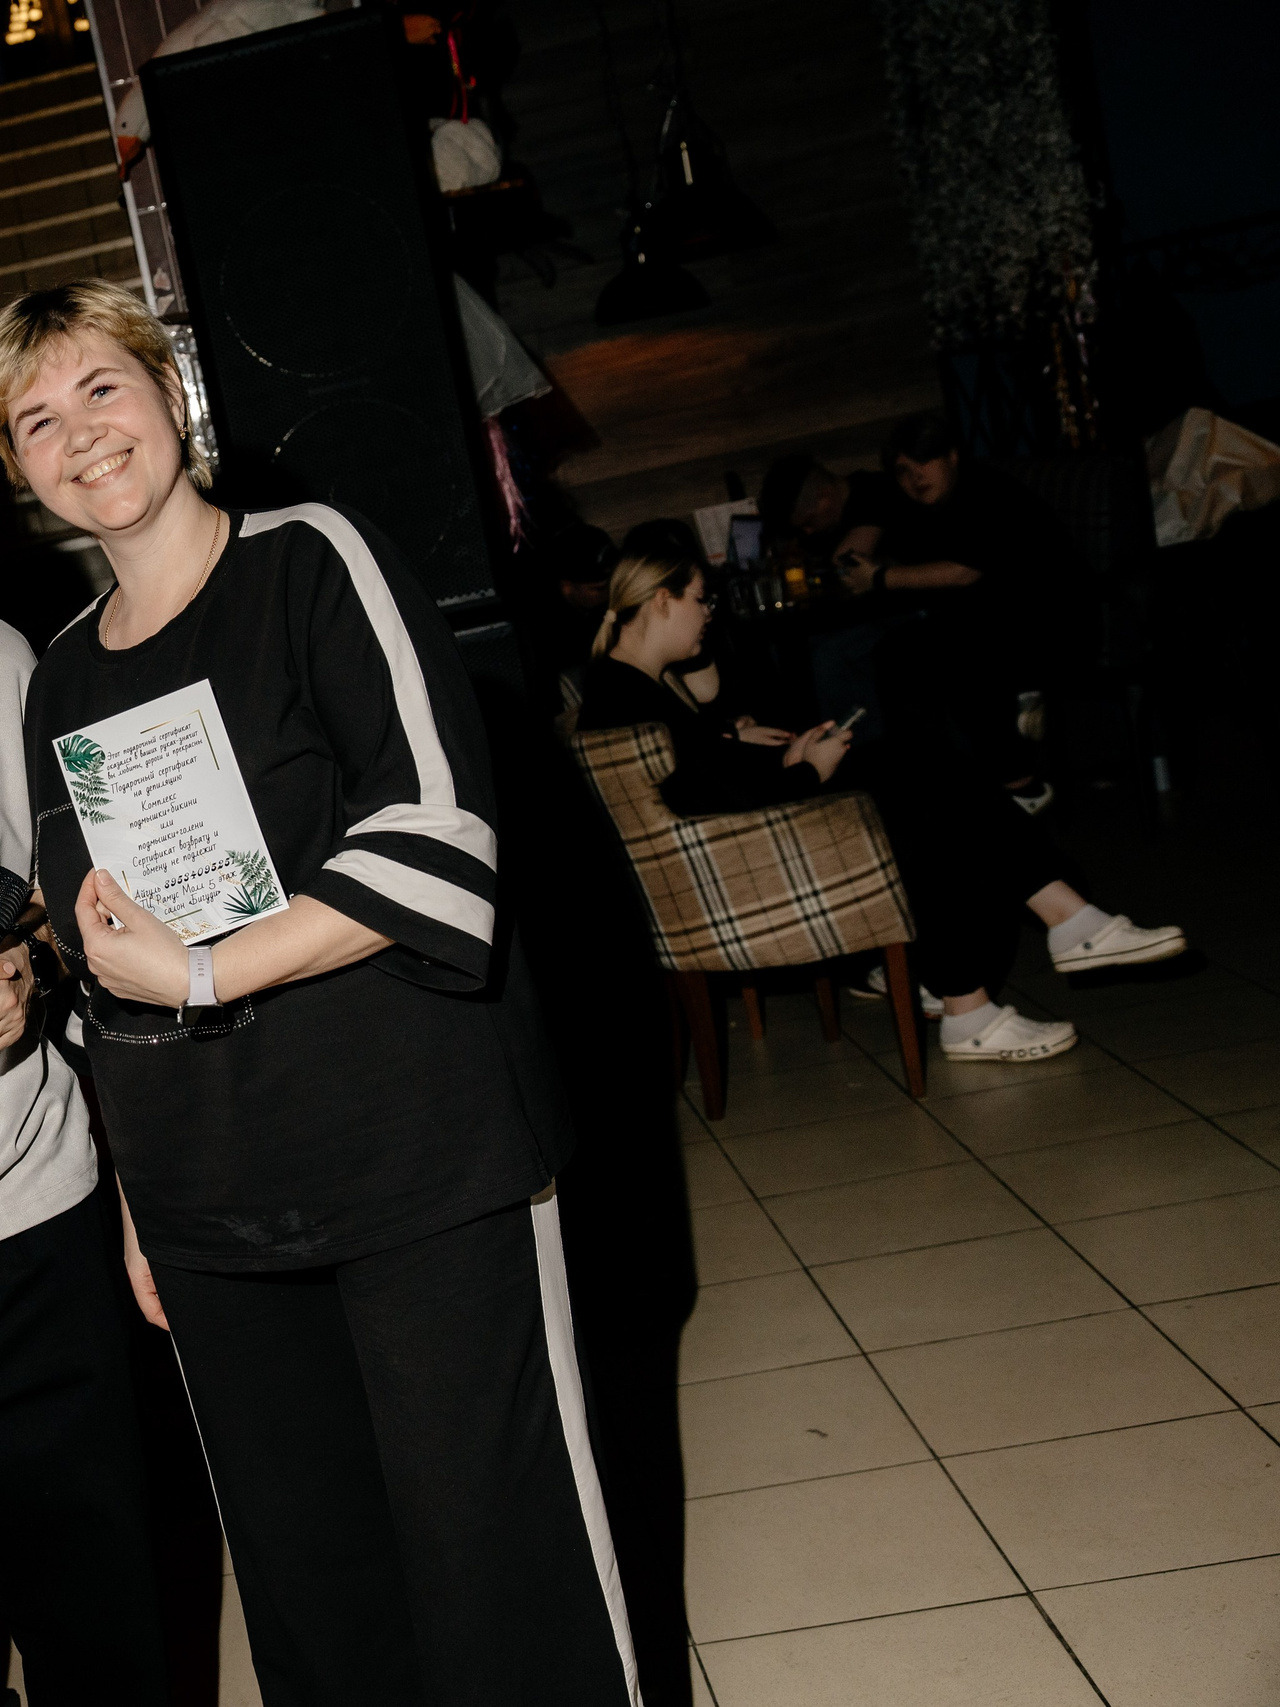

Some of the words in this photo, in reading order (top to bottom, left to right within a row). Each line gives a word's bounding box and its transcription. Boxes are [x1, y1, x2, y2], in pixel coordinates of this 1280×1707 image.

[106, 750, 120, 762] Этот
[123, 736, 157, 755] подарочный
[159, 722, 192, 742] сертификат
[106, 755, 133, 772] оказался
[139, 746, 158, 759] ваших
[107, 770, 117, 780] вы
[144, 752, 164, 769] дороги
[172, 739, 204, 756] прекрасны
[110, 770, 155, 795] Подарочный
[158, 756, 198, 778] сертификат
[133, 789, 143, 798] на
[145, 773, 183, 797] депиляцию
[129, 798, 198, 830] подмышки+бикини
[140, 792, 177, 812] Комплекс
[138, 820, 204, 851] подмышки+голени
[159, 818, 175, 830] или
[132, 845, 177, 868] Сертификат
[178, 833, 211, 852] возврату
[213, 830, 219, 838] и
[142, 861, 168, 877] обмену
[171, 858, 180, 868] не
[182, 843, 217, 863] подлежит
[133, 886, 161, 902] Айгуль
[139, 897, 156, 914] ТЦ
[156, 891, 180, 906] Рамус
[181, 881, 205, 895] Молл
[208, 878, 217, 890] 5
[218, 870, 238, 883] этаж
[164, 901, 186, 916] салон
